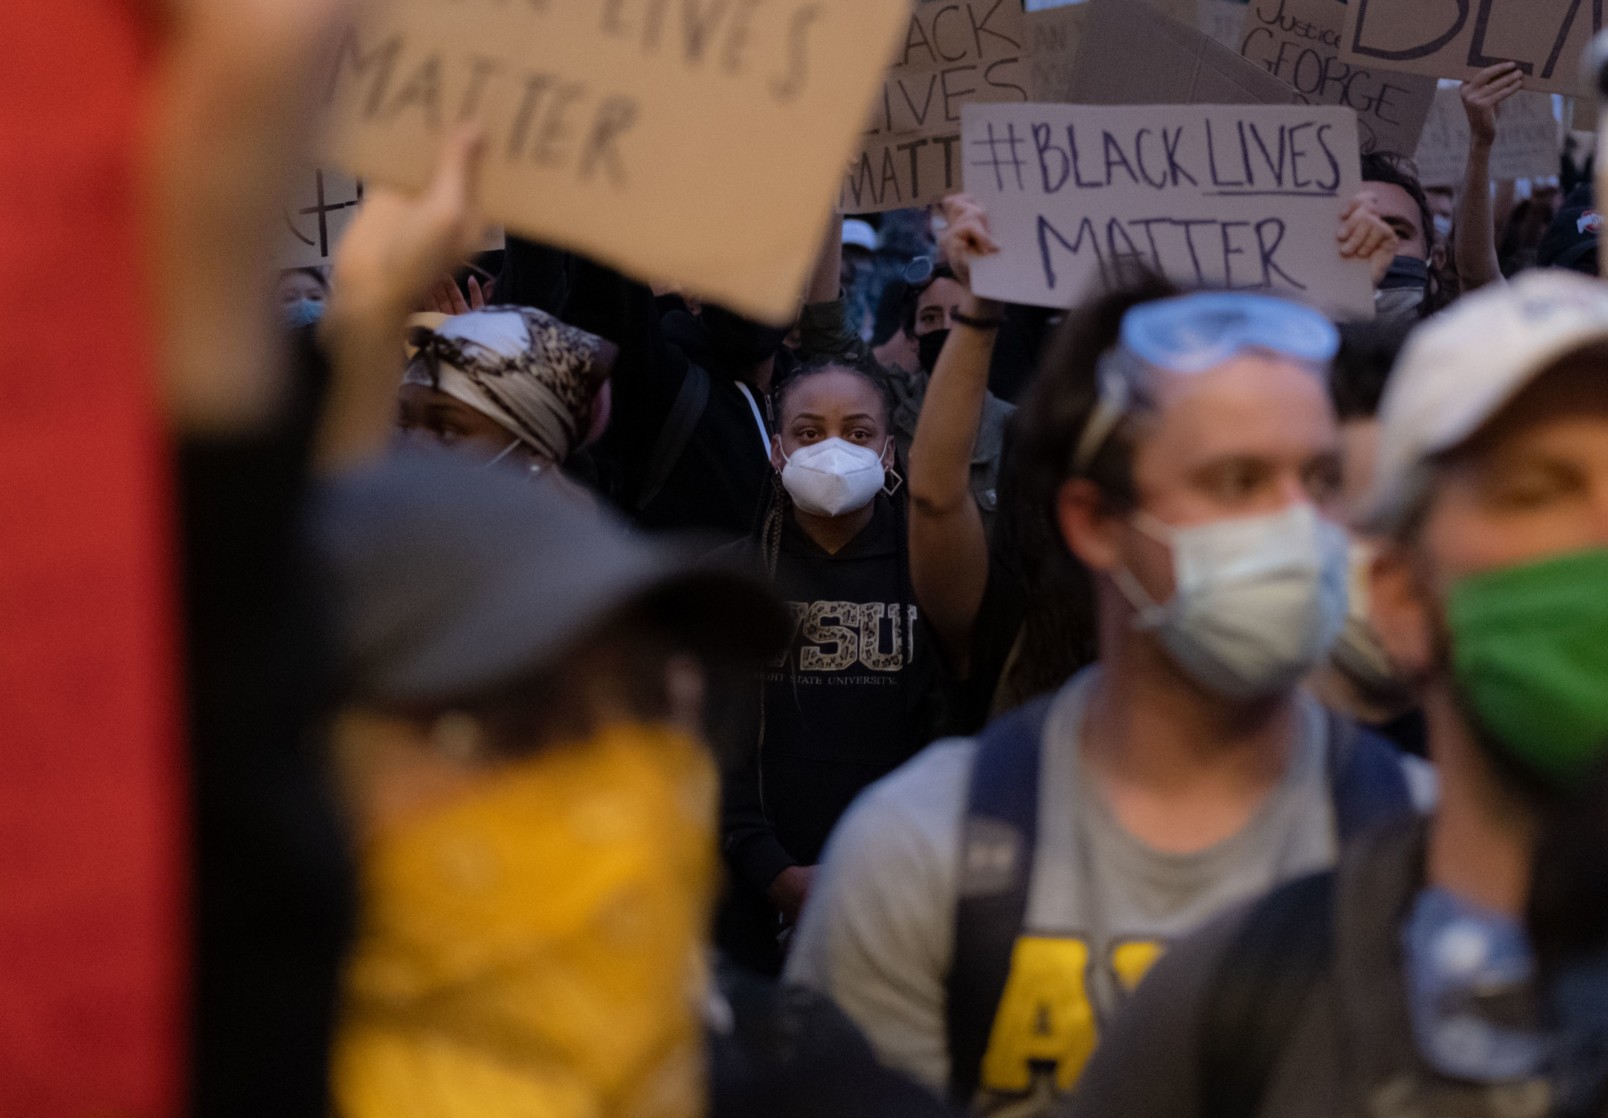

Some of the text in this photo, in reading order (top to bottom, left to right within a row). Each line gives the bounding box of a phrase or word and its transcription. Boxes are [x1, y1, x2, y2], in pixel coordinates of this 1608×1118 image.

[894, 0, 1022, 67] ACK
[326, 26, 639, 190] MATTER
[866, 57, 1028, 134] IVES
[1241, 27, 1411, 126] GEORGE
[840, 136, 960, 208] MATT
[1036, 213, 1307, 290] MATTER
